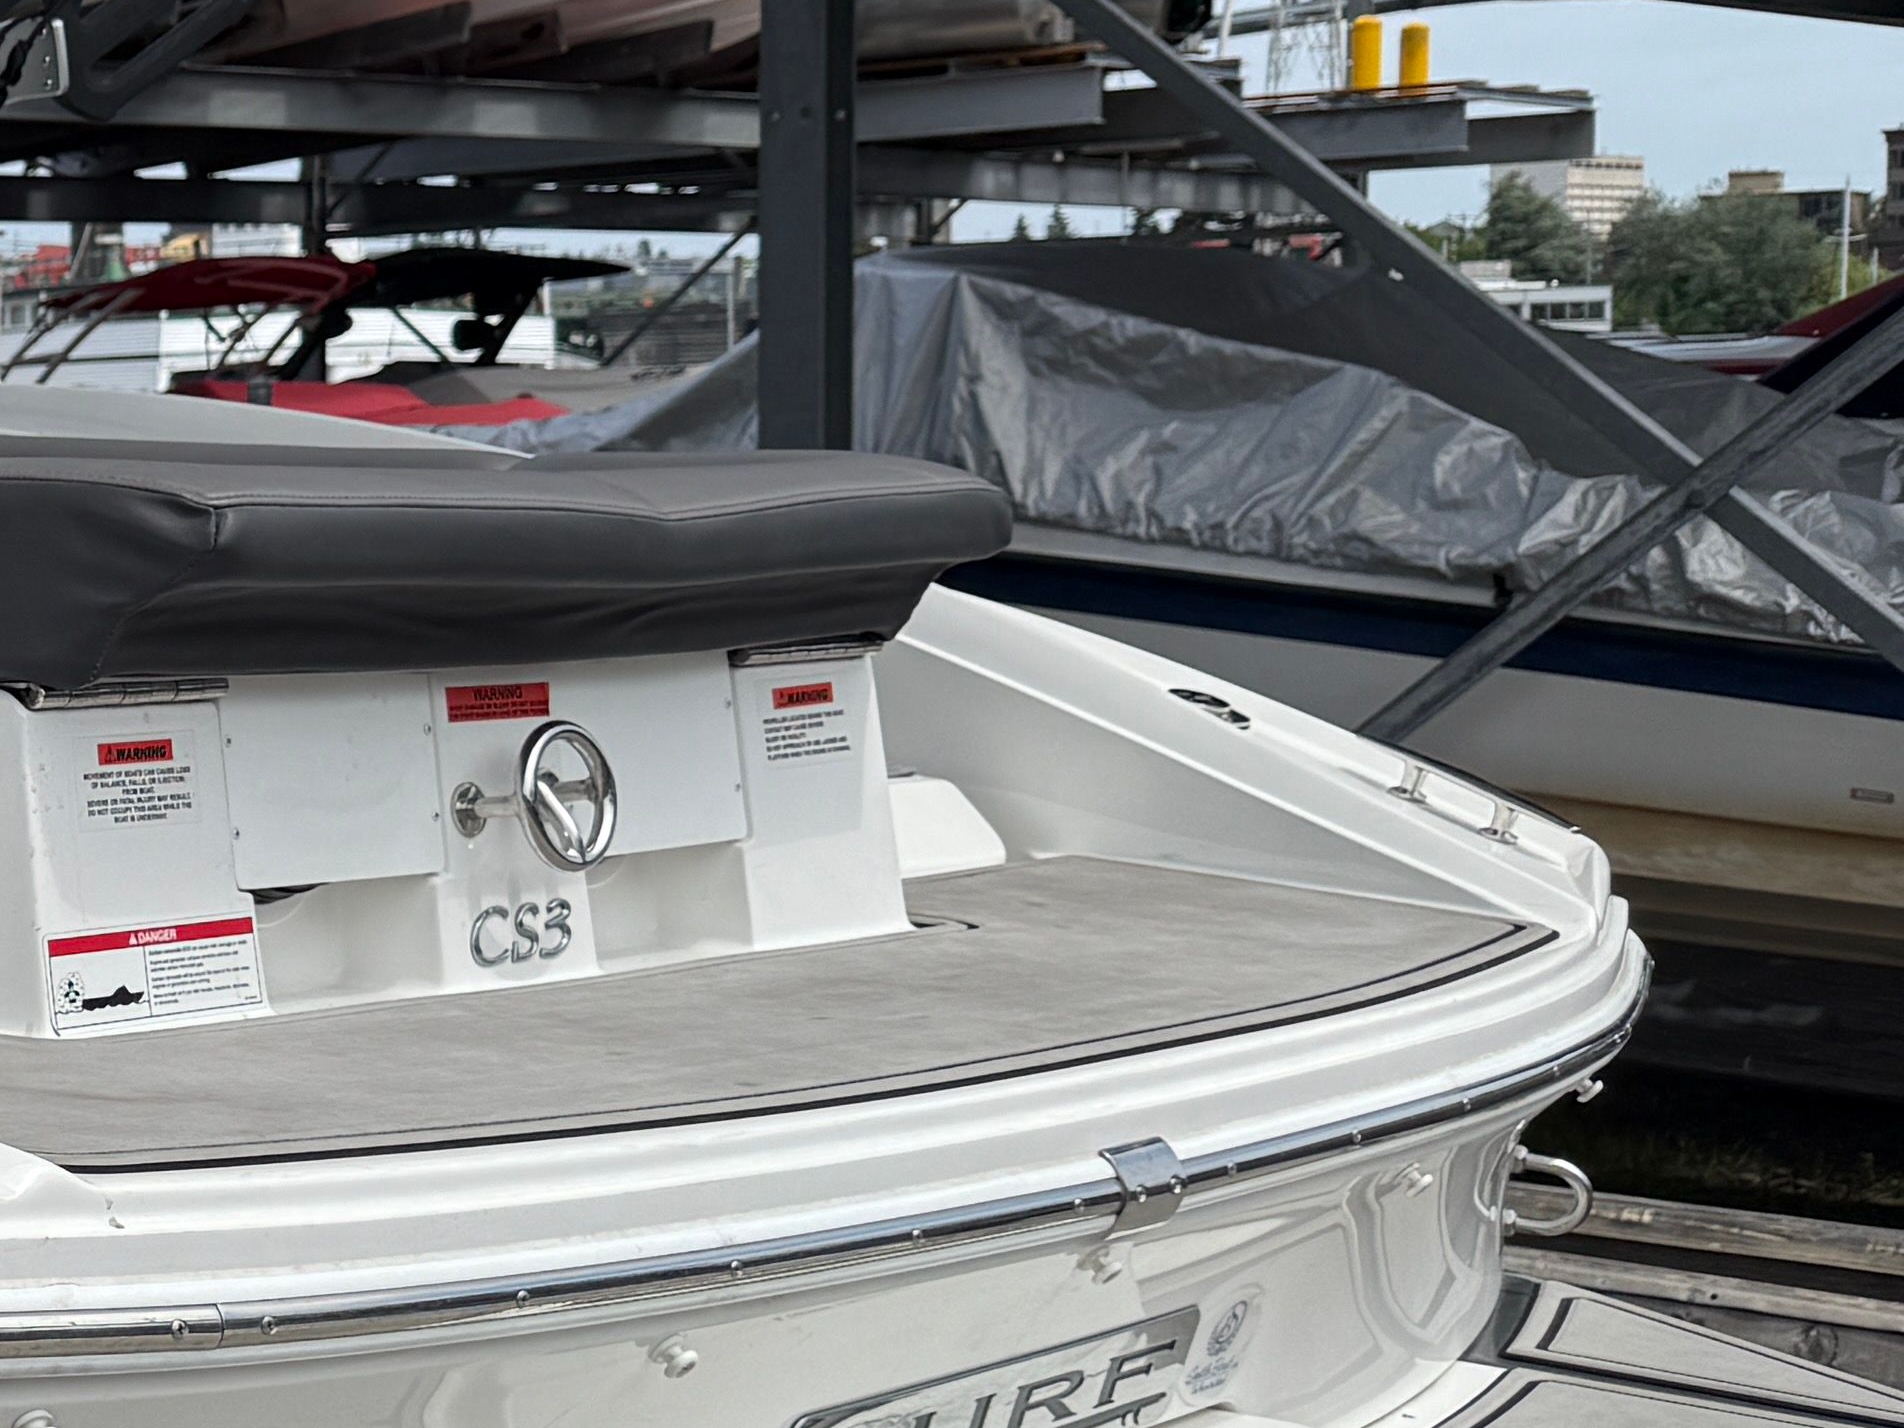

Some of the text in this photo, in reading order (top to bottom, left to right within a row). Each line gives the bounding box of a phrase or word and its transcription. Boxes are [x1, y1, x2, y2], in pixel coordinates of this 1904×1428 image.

[115, 745, 167, 762] WARNING
[138, 928, 178, 945] DANGER
[470, 898, 572, 967] CS3
